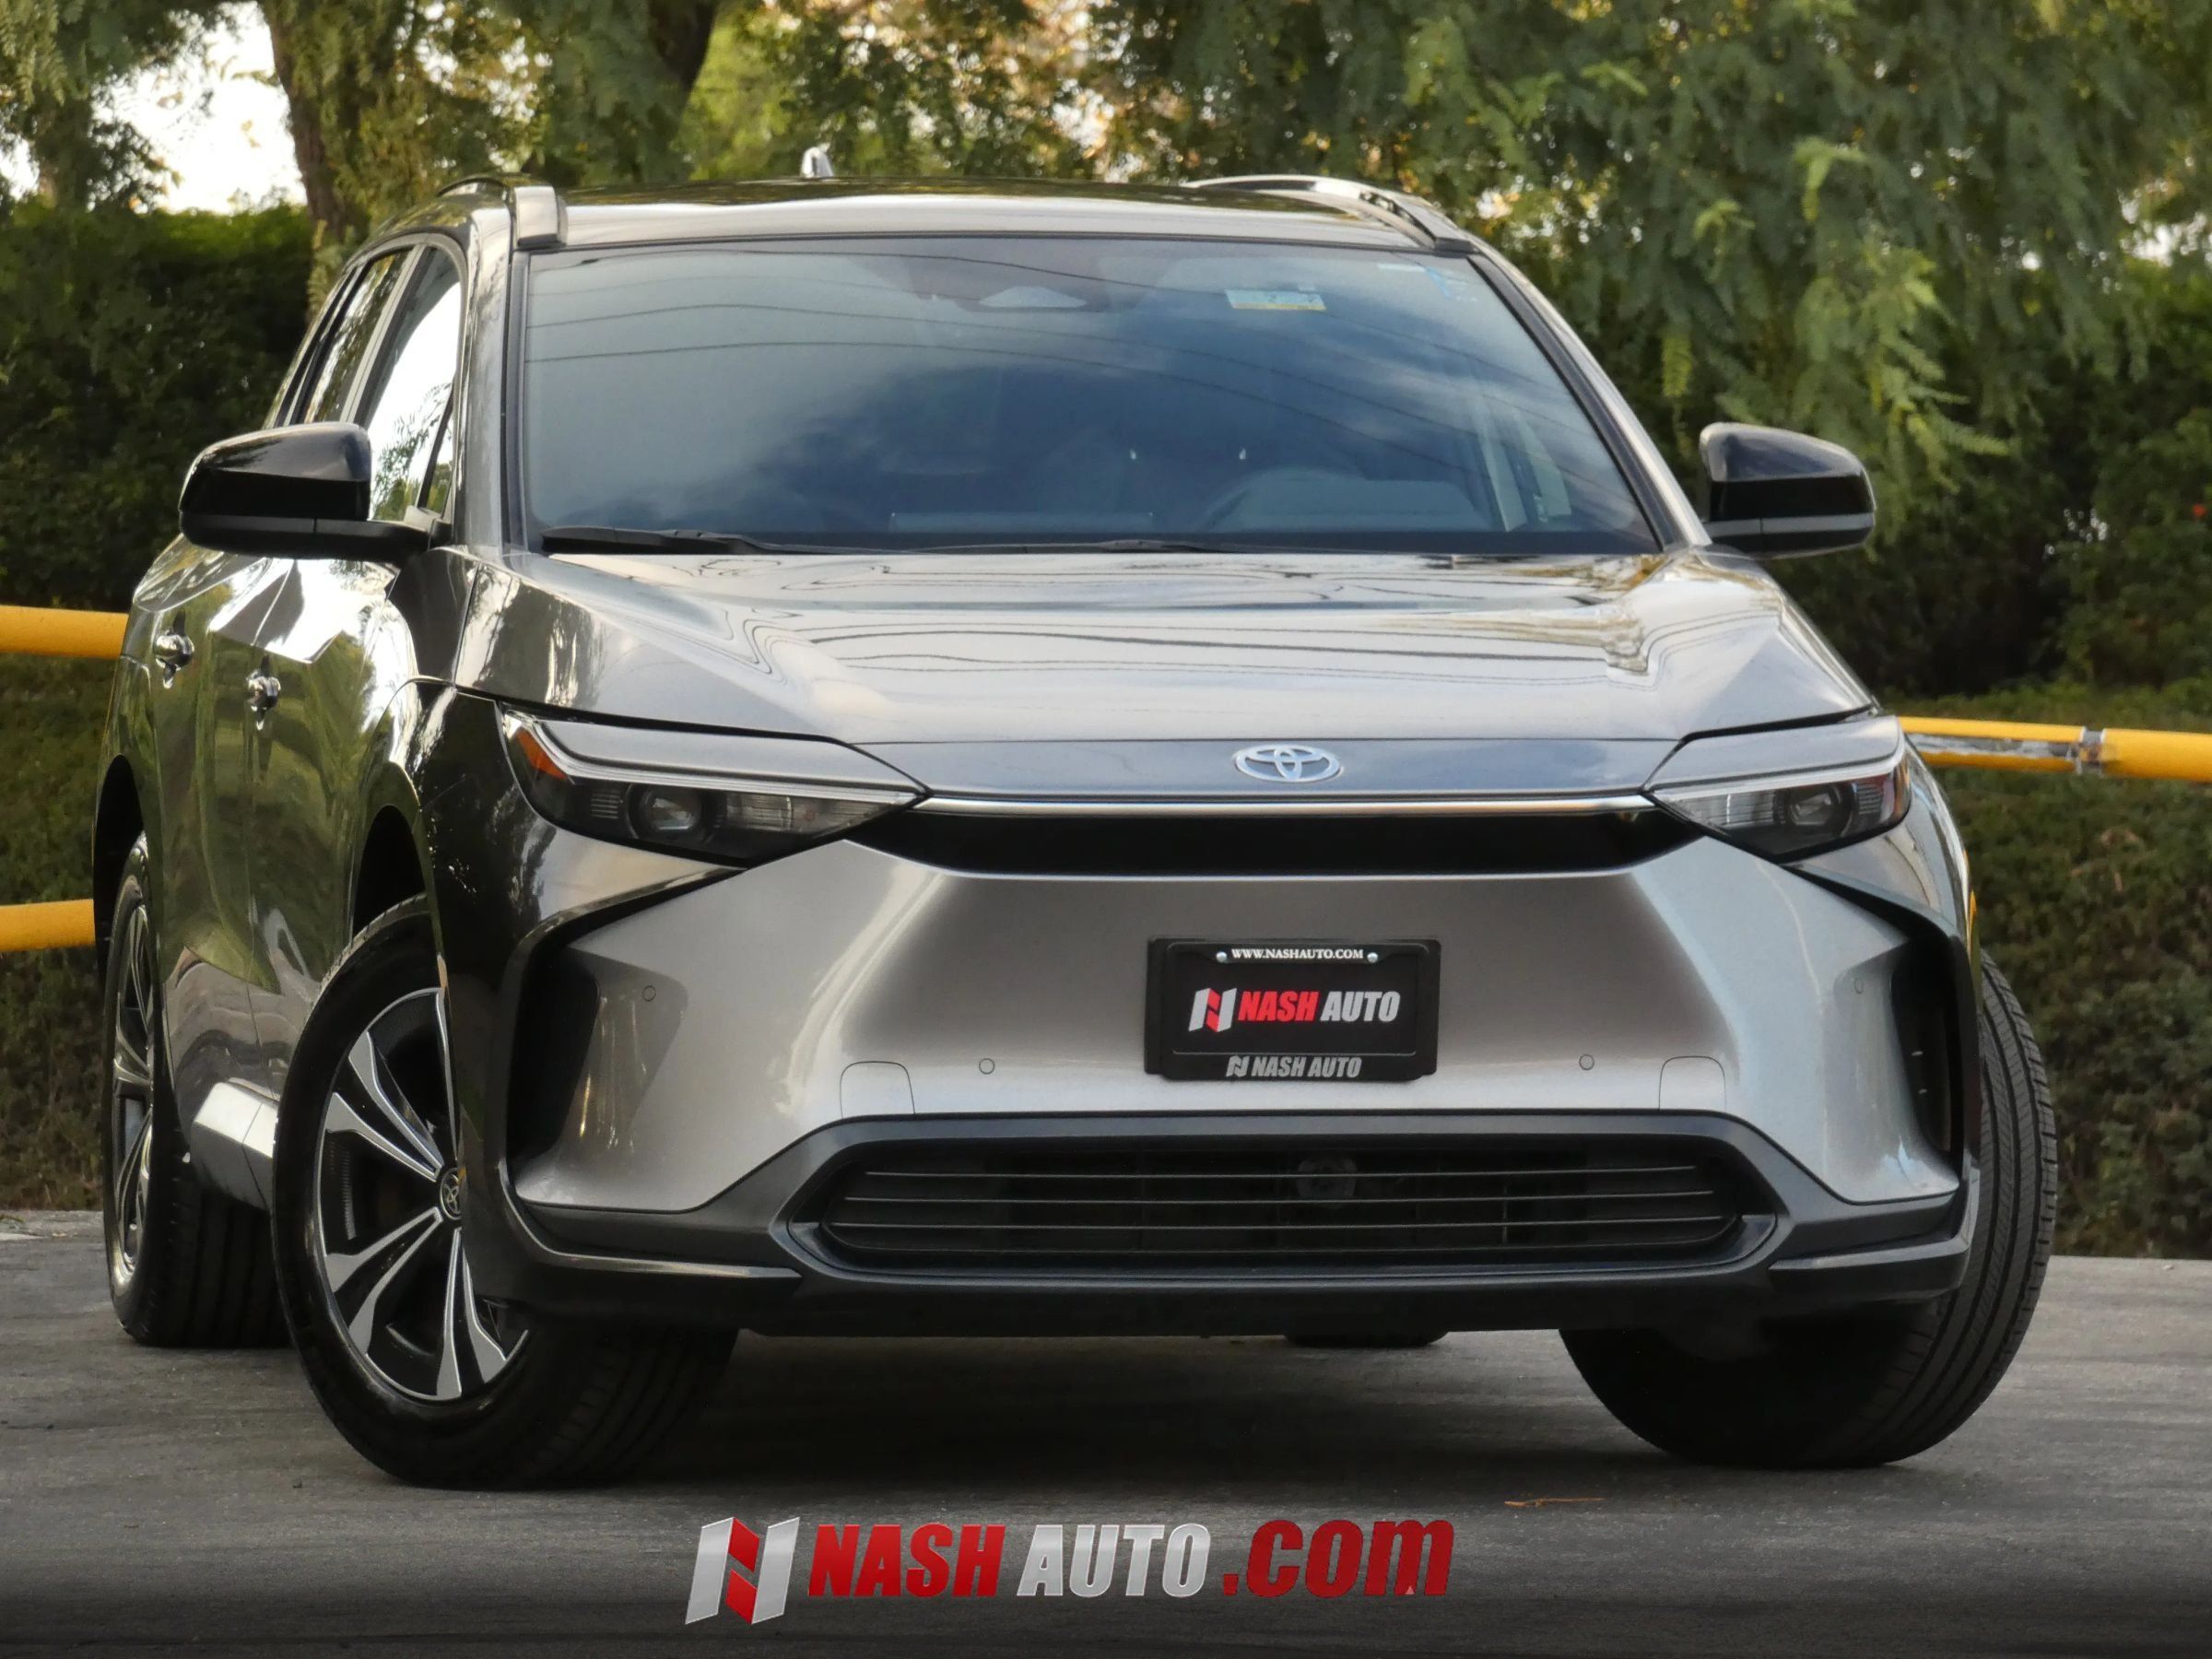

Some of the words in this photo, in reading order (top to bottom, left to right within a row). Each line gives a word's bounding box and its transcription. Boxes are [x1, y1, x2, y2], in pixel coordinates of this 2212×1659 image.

[1231, 947, 1364, 960] WWW.NASHAUTO.COM
[1238, 991, 1320, 1022] NASH
[1320, 991, 1401, 1023] AUTO
[1251, 1056, 1307, 1077] NASH
[1307, 1057, 1362, 1078] AUTO
